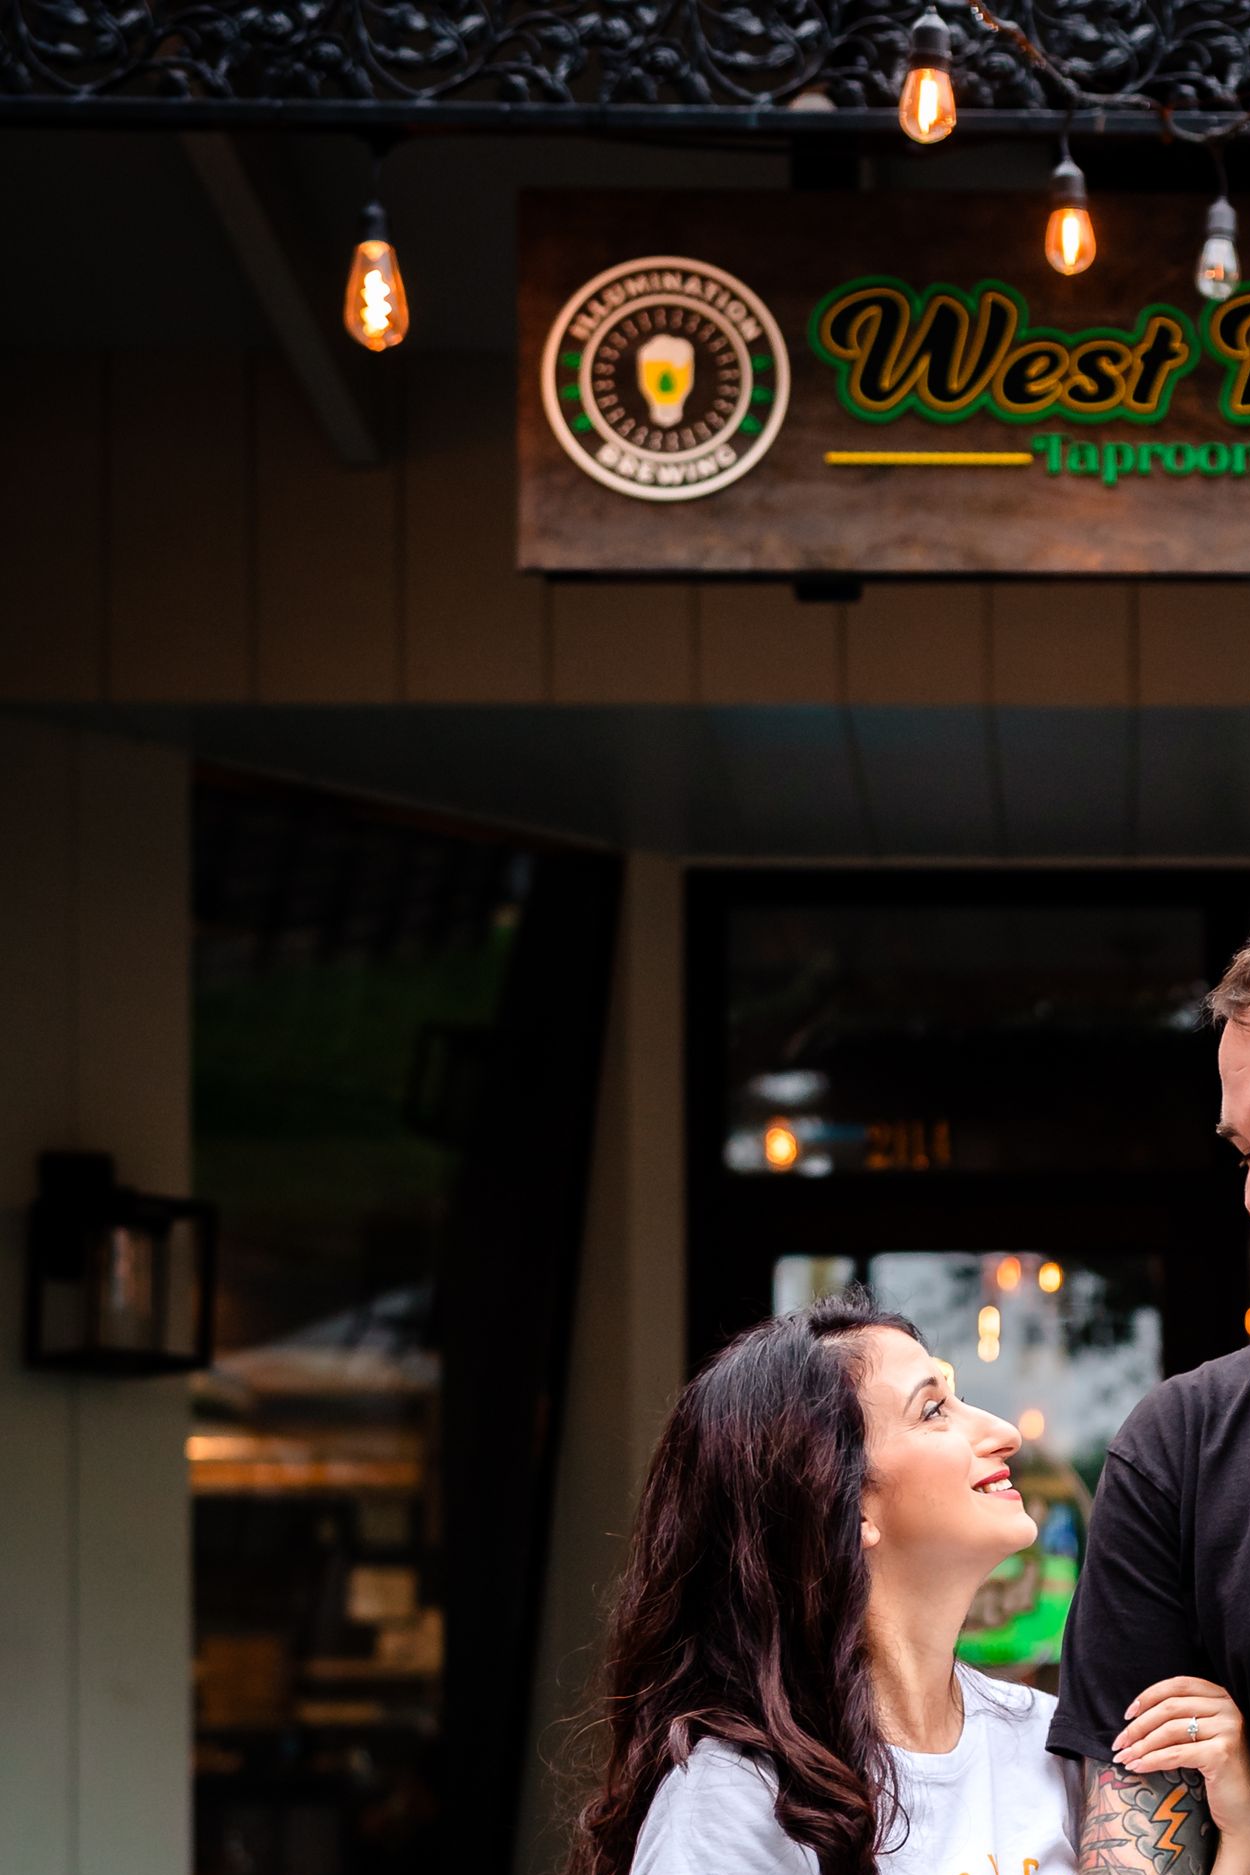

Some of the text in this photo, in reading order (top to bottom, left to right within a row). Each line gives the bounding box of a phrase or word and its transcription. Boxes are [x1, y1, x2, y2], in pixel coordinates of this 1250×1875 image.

[568, 270, 763, 344] ILLUMINATION
[815, 282, 1196, 418] West
[594, 442, 739, 486] BREWING
